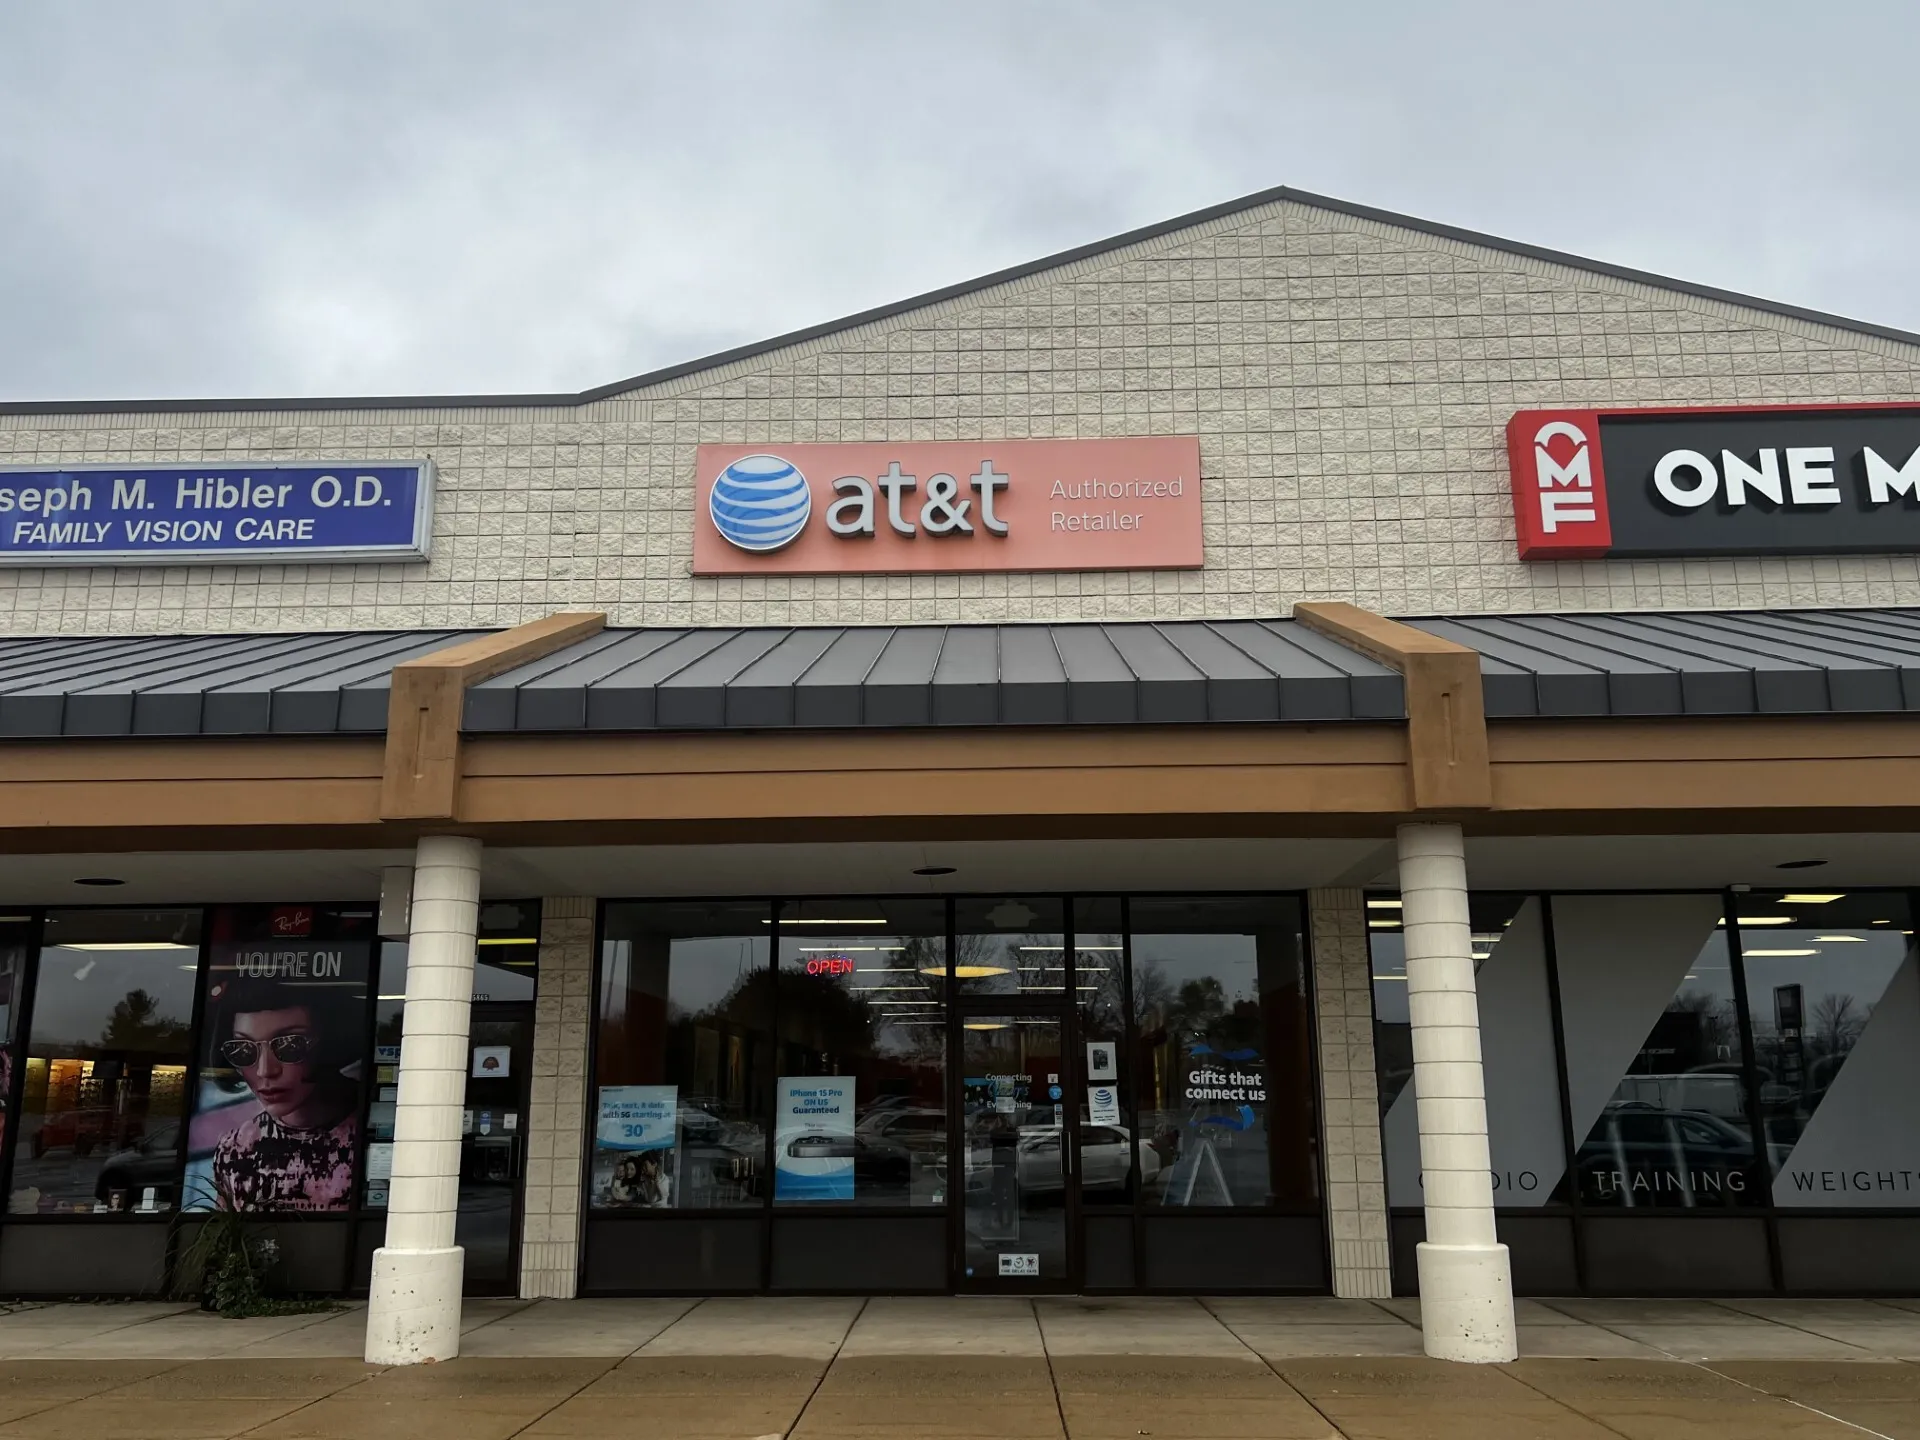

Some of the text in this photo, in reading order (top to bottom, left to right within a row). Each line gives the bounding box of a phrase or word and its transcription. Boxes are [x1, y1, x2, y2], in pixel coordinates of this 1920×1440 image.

[1653, 446, 1842, 508] ONE
[111, 478, 155, 510] M.
[175, 476, 293, 509] Hibler
[310, 475, 392, 508] O.D.
[825, 459, 1009, 538] at&t
[1050, 476, 1183, 500] Authorized
[13, 518, 315, 544] FAMILY VISION CARE
[1051, 510, 1144, 532] Retailer
[235, 951, 342, 978] YOU'RE ON
[807, 958, 853, 975] OPEN
[1188, 1070, 1262, 1086] Gifts that
[790, 1089, 843, 1097] iPhone 15 Pro
[1185, 1087, 1267, 1101] connect us
[632, 1111, 662, 1119] starting
[792, 1106, 840, 1114] Guaranteed
[1592, 1171, 1746, 1191] TRAINING
[1792, 1170, 1920, 1191] WEIGHT
